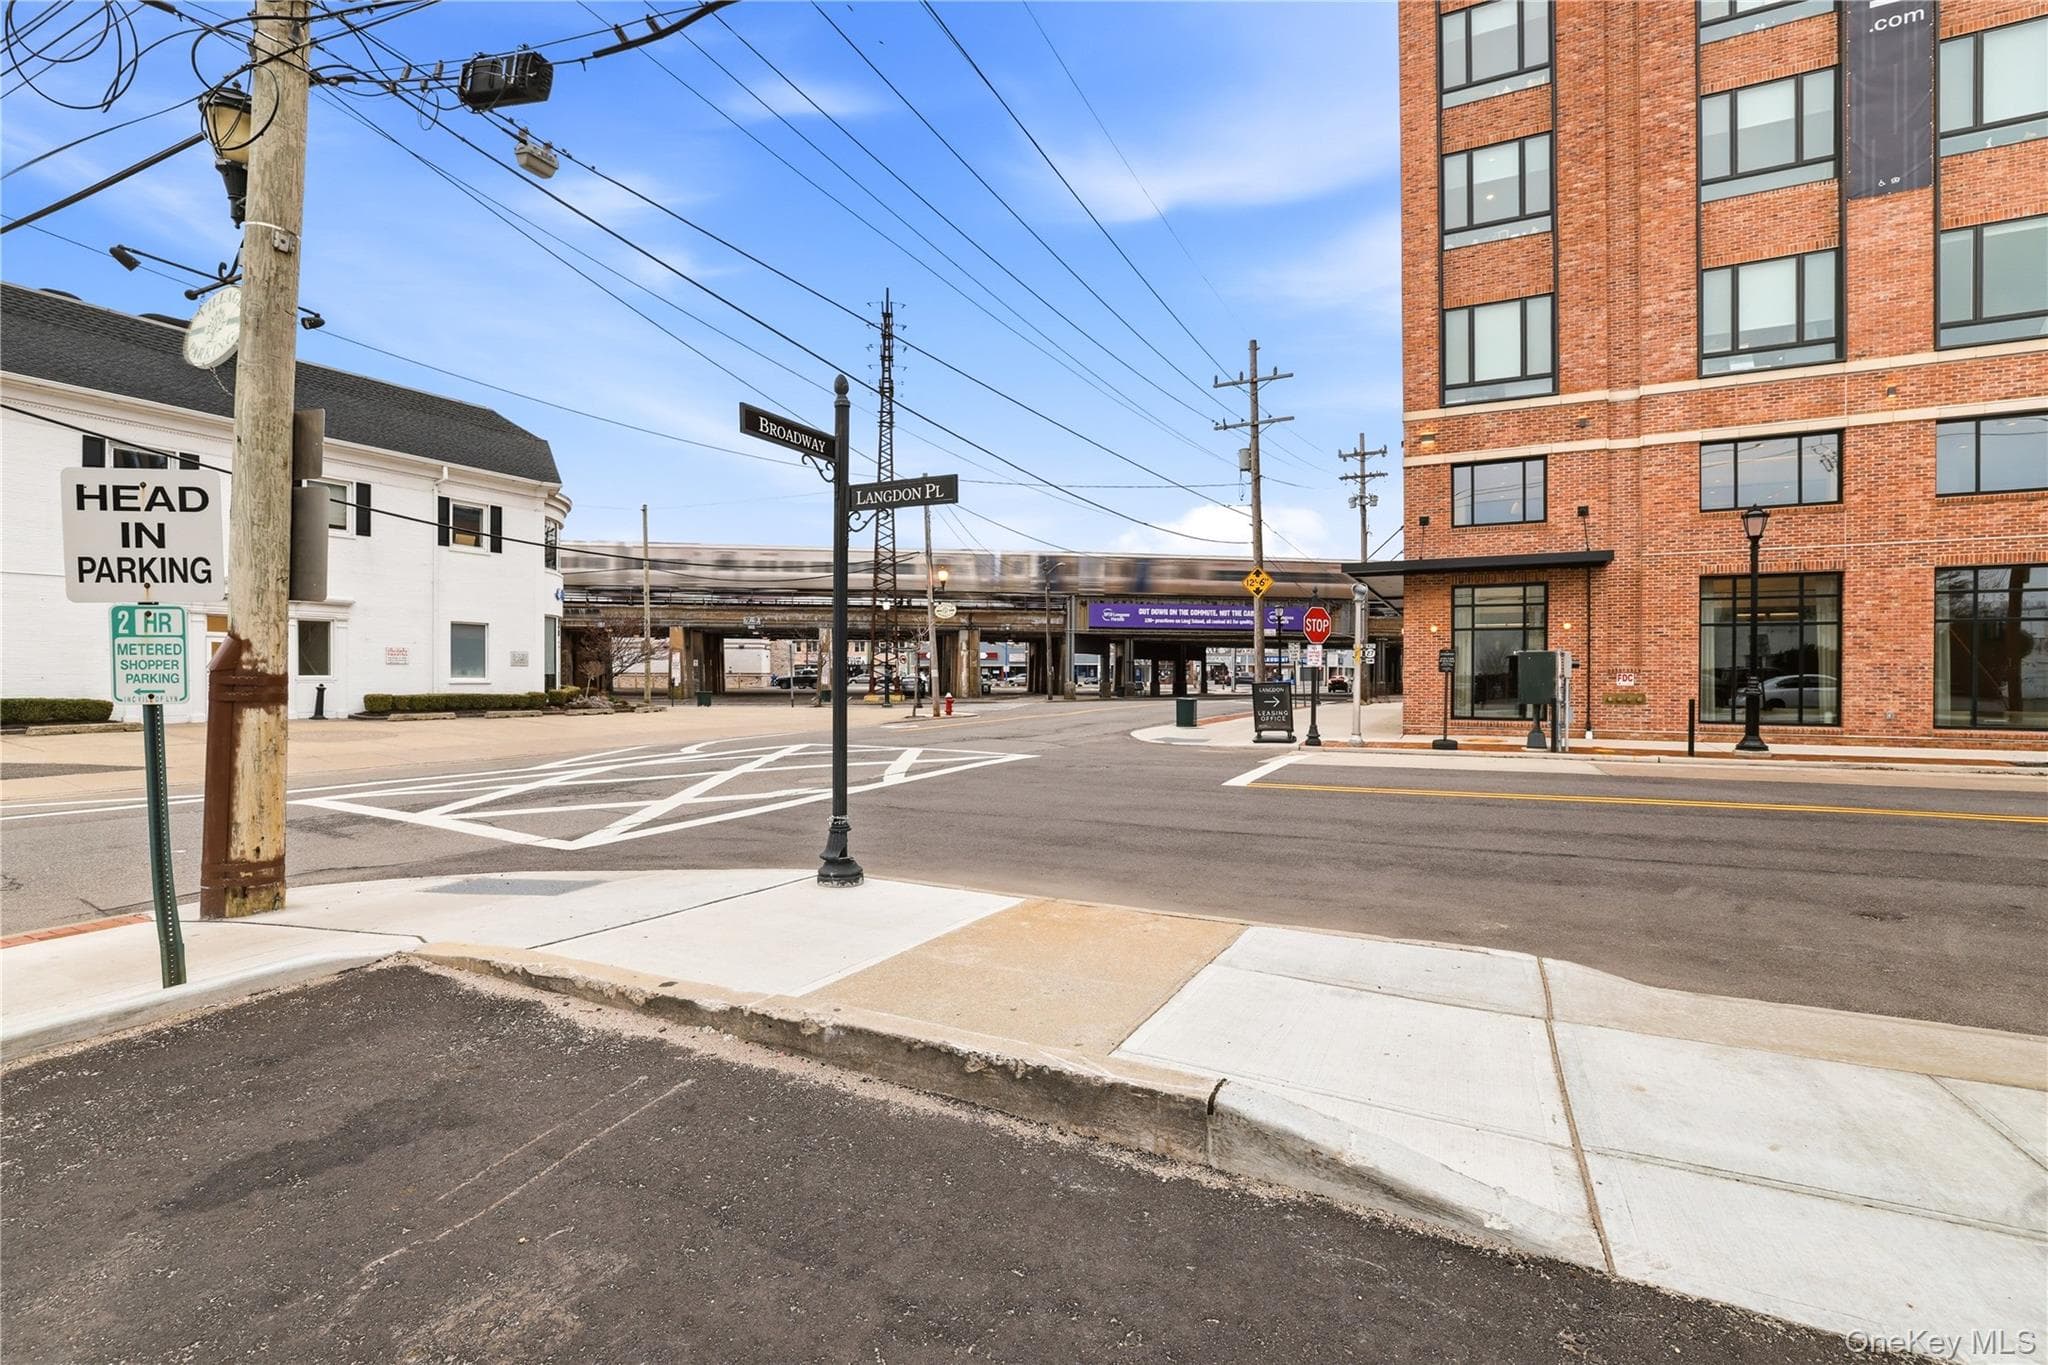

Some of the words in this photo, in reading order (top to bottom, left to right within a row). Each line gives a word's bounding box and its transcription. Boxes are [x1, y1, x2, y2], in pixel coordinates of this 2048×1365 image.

[1869, 8, 1925, 33] .com
[75, 483, 209, 512] HEAD
[120, 522, 166, 549] IN
[77, 557, 212, 584] PARKING
[117, 610, 129, 635] 2
[144, 612, 172, 633] HR
[1306, 618, 1329, 632] STOP
[117, 643, 182, 656] METERED
[120, 660, 179, 670] SHOPPER
[126, 673, 179, 684] PARKING
[1617, 674, 1633, 682] FDC
